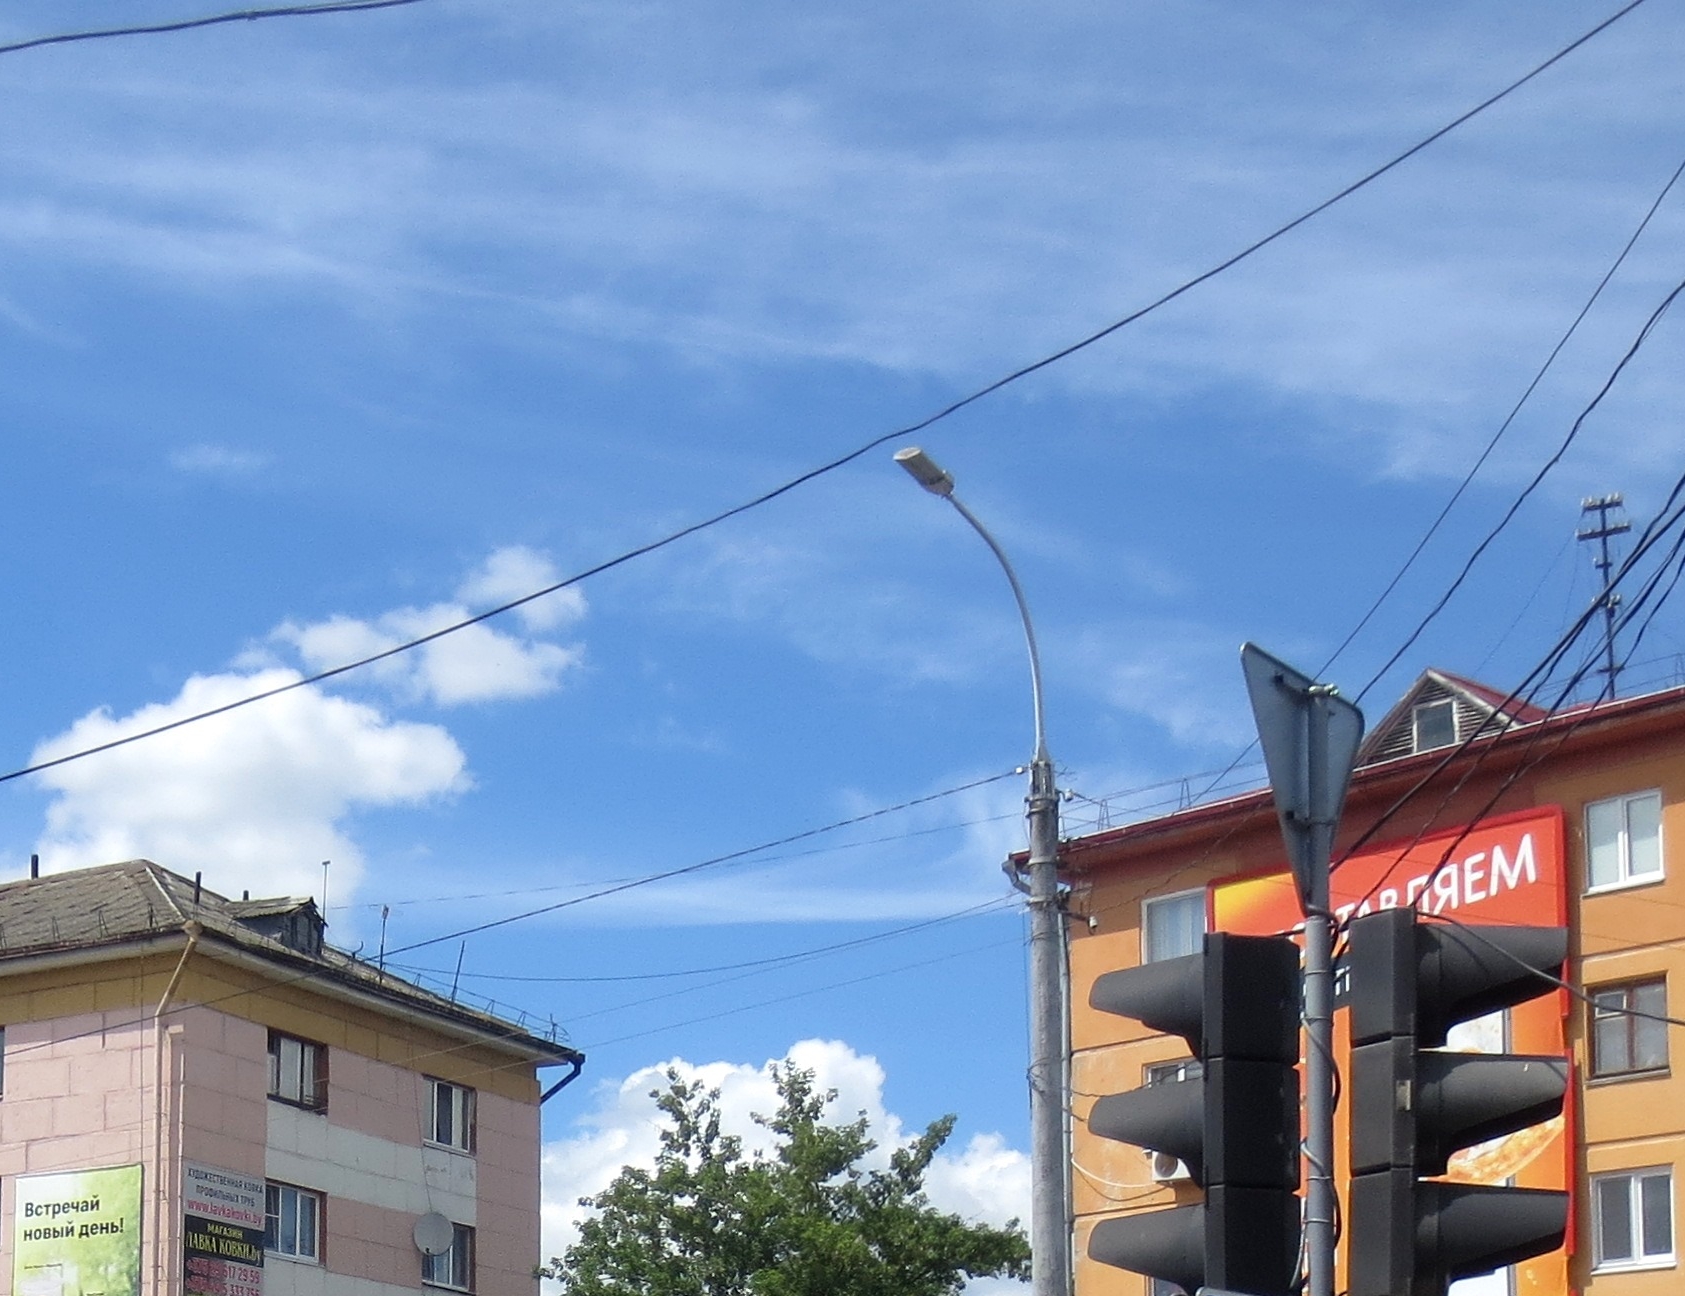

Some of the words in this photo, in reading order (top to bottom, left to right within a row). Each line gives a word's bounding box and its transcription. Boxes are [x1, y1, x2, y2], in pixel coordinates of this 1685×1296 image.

[24, 1194, 100, 1219] Встречай
[240, 1195, 255, 1207] ТРУБ
[23, 1220, 75, 1241] новый
[78, 1217, 124, 1239] день!
[207, 1223, 244, 1240] МАГАЗИН
